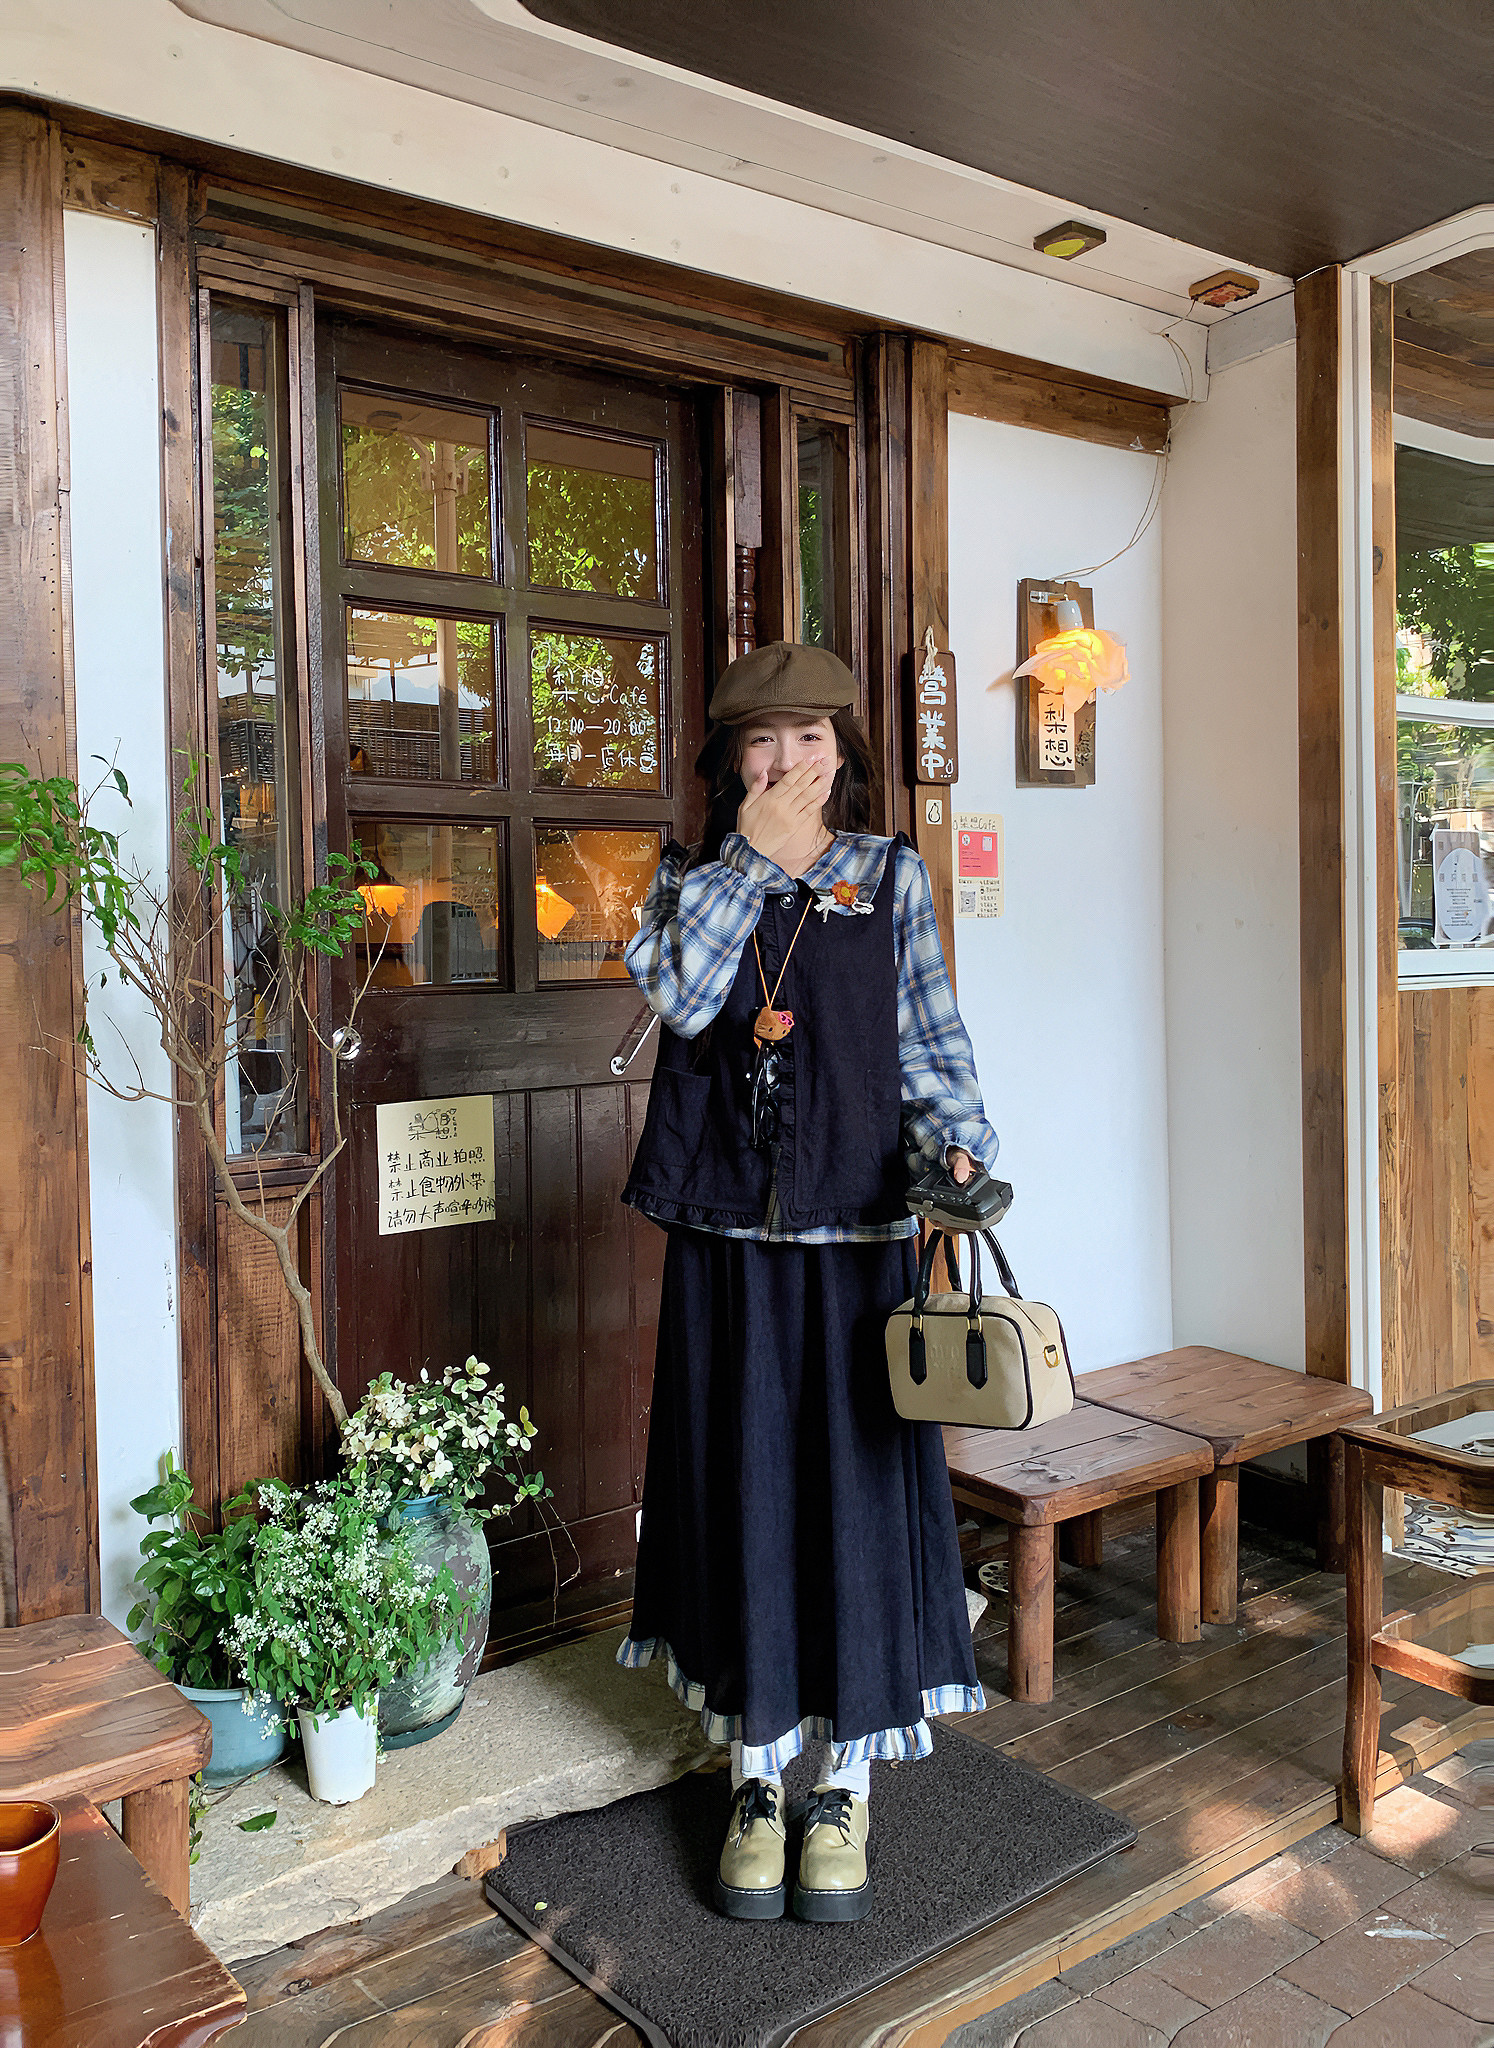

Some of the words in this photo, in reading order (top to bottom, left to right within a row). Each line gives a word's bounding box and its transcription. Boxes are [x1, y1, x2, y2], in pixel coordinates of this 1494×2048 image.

[1043, 702, 1073, 767] 梨想
[387, 1146, 485, 1173] 禁止商业拍照
[388, 1172, 486, 1201] 禁止食物外带
